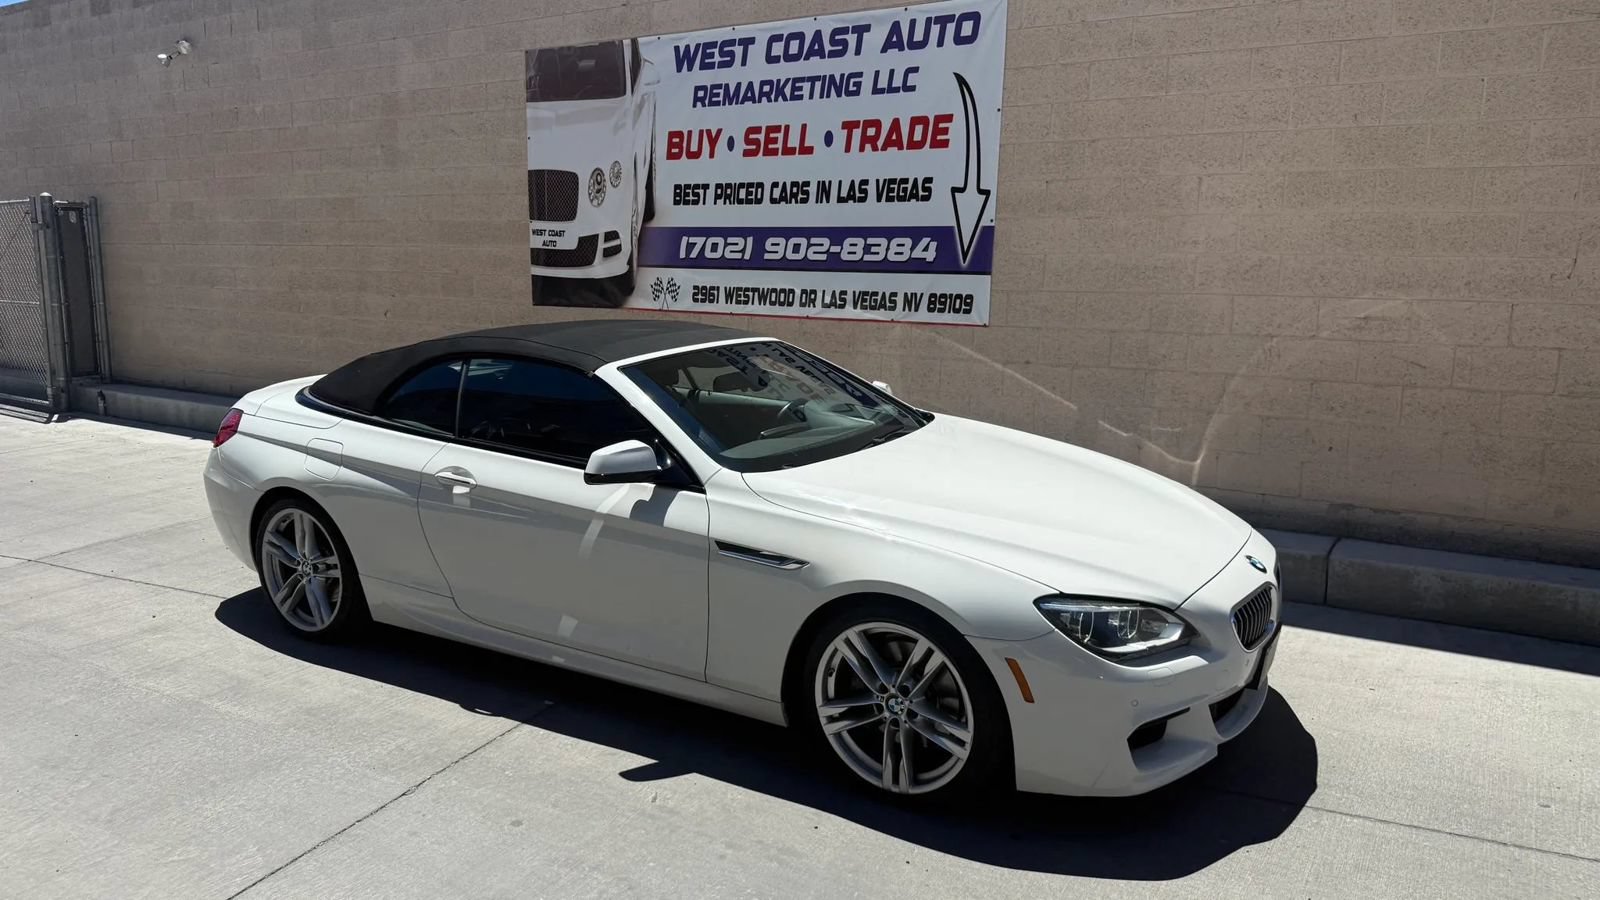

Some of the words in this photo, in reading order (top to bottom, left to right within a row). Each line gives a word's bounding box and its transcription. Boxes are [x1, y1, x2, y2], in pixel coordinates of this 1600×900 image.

[673, 36, 756, 73] WEST
[765, 23, 872, 65] COAST
[880, 11, 982, 54] AUTO
[692, 71, 864, 108] REMARKETING
[871, 66, 920, 96] LLC
[665, 128, 723, 161] BUY
[742, 123, 815, 158] SELL
[841, 113, 954, 153] TRADE
[672, 183, 710, 206] BEST
[713, 181, 764, 206] PRICED
[769, 180, 811, 205] CARS
[816, 179, 833, 204] IN
[836, 178, 870, 204] LAS
[875, 176, 934, 203] VEGAS
[763, 235, 938, 263] 902-8384
[691, 285, 719, 304] 2961
[724, 286, 795, 308] WESTWOOD
[799, 288, 817, 309] DR
[821, 289, 847, 309] LAS
[852, 289, 898, 312] VEGAS
[902, 292, 924, 313] NV
[927, 293, 975, 315] 89109
